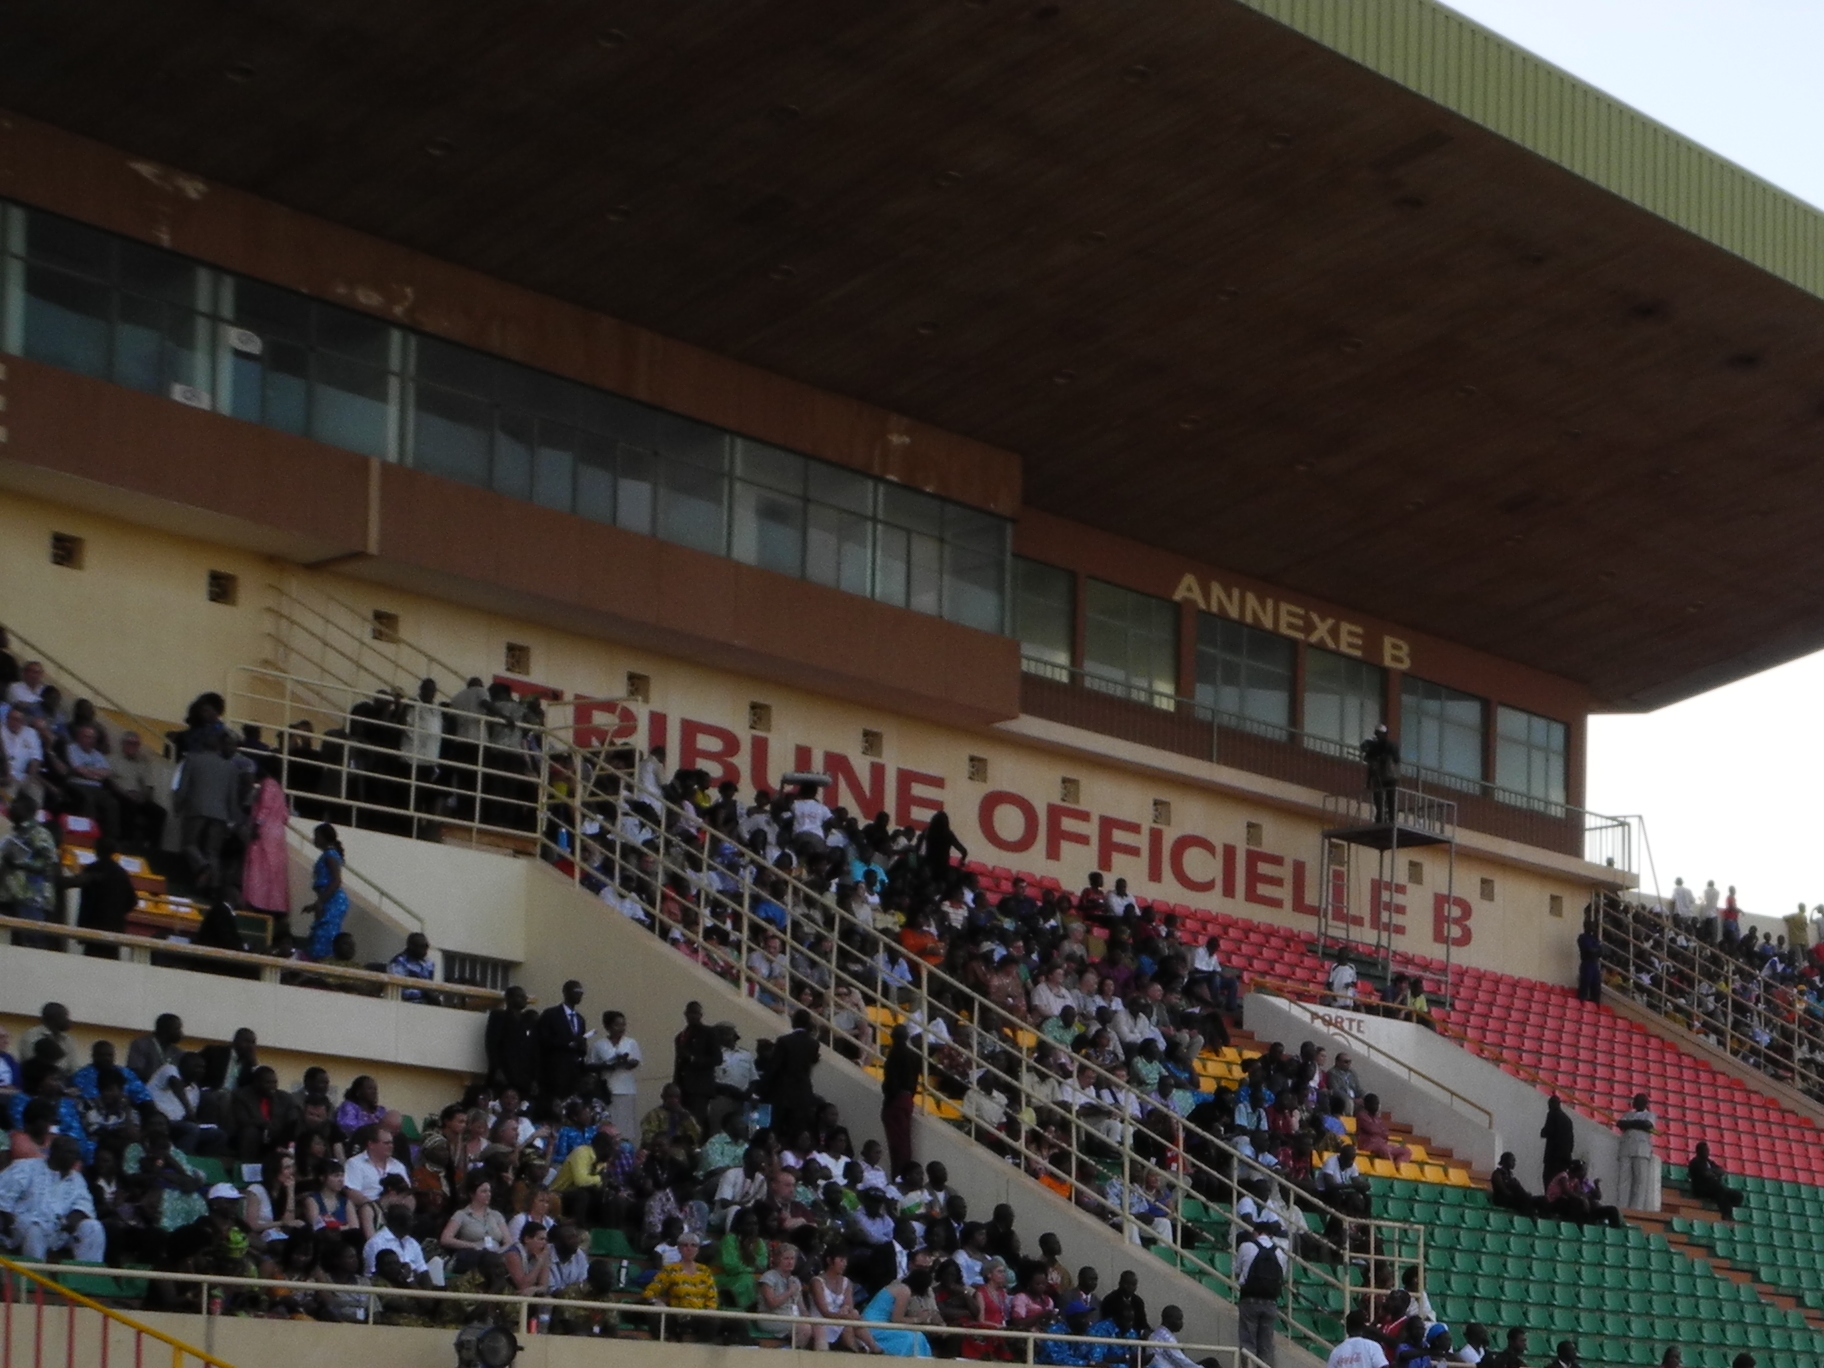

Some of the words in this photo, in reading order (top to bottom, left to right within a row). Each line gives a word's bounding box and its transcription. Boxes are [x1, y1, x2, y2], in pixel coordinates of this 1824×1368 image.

[1172, 573, 1364, 658] ANNEXE
[1382, 635, 1411, 670] B
[978, 790, 1407, 935] OFFICIELLE
[1433, 892, 1472, 948] B
[1310, 1013, 1366, 1034] PORTE
